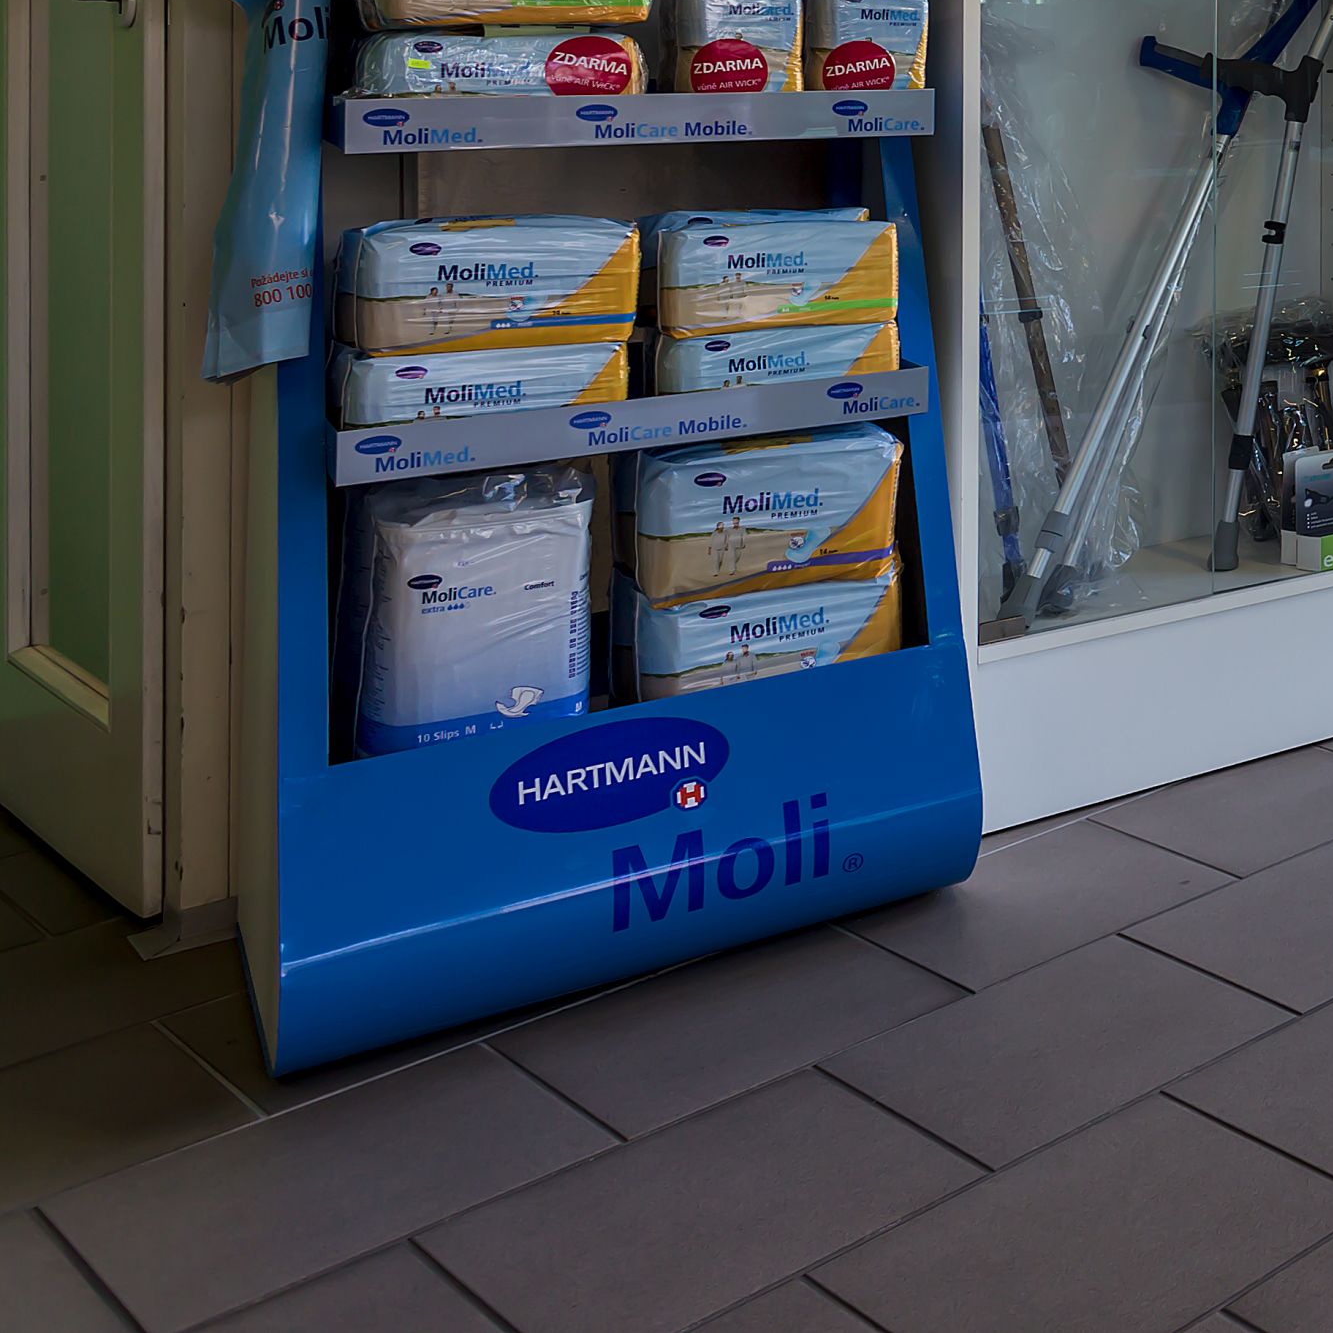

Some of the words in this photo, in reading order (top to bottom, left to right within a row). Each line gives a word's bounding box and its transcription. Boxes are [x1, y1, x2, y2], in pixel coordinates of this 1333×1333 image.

[552, 51, 629, 75] ZDARMA
[693, 57, 764, 75] ZDARMA
[825, 56, 891, 78] ZDARMA
[574, 77, 590, 87] AIR
[719, 81, 734, 89] AIR
[851, 80, 865, 89] AIR
[594, 123, 678, 140] MoliCare
[766, 267, 805, 275] PREMIUM
[486, 278, 534, 287] PREMIUM
[253, 288, 282, 308] 800
[285, 283, 313, 300] 100
[767, 366, 806, 377] PREMIUM
[473, 398, 522, 408] PREMIUM
[588, 421, 673, 447] MoliCare
[771, 509, 819, 520] PREMIUM
[524, 580, 555, 591] Comfort
[421, 604, 446, 615] extra
[779, 626, 826, 642] PREMIUM
[417, 733, 431, 743] 10
[433, 728, 460, 742] Slips
[464, 724, 476, 735] M
[517, 740, 707, 806] HARTMANN
